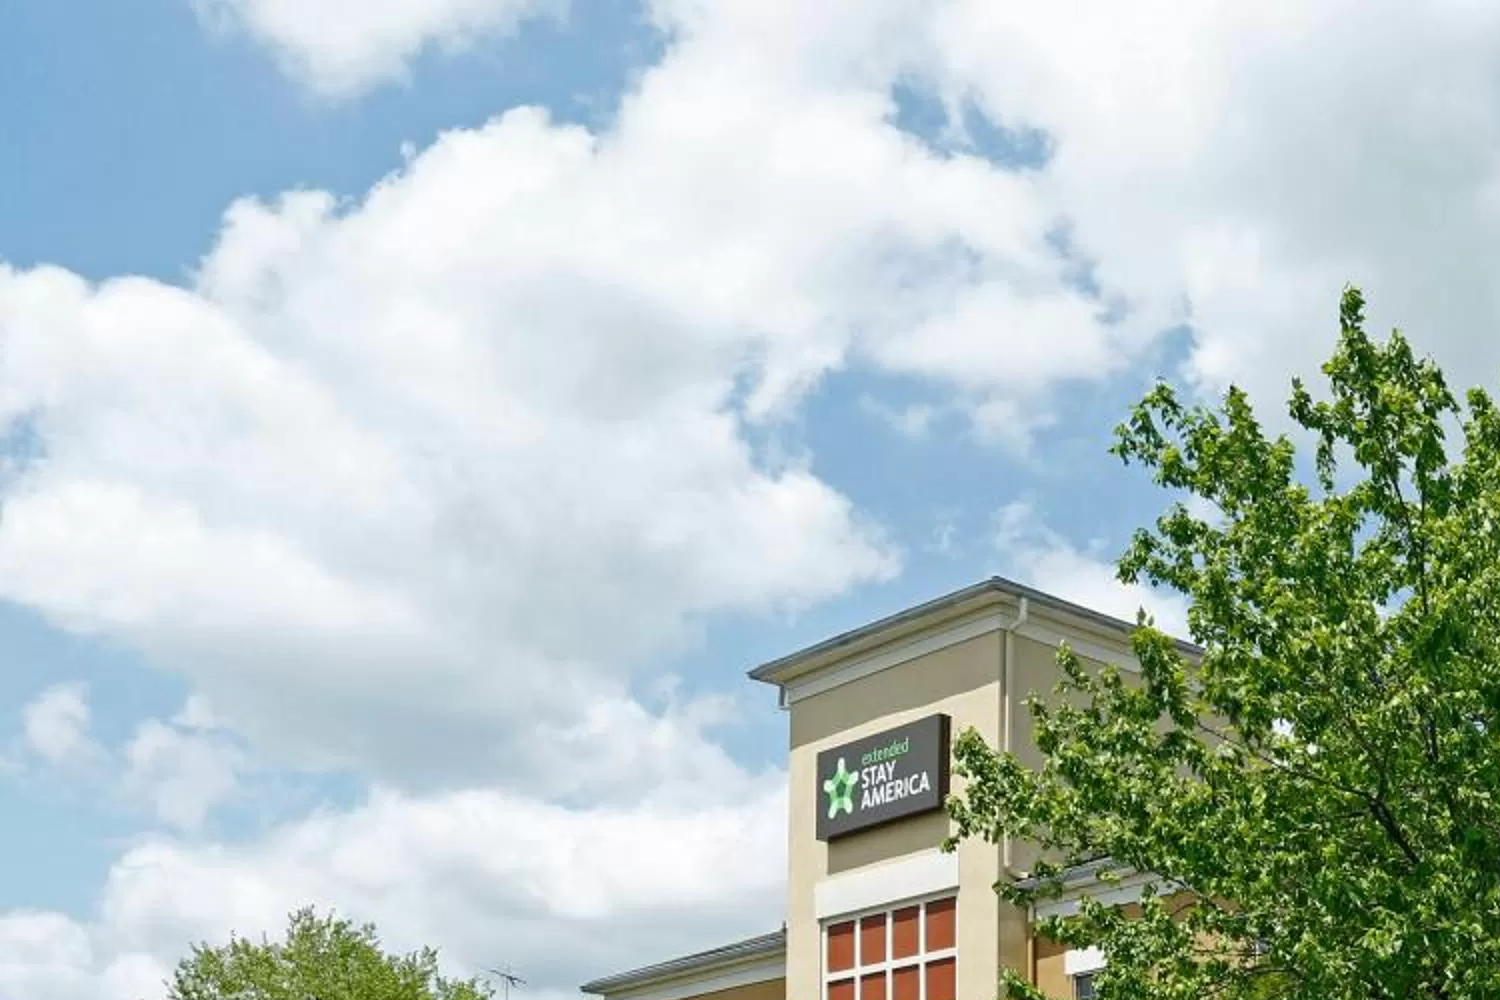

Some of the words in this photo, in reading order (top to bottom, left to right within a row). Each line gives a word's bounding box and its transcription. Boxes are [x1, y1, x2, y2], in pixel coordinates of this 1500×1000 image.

[861, 737, 909, 765] extended
[861, 760, 897, 789] STAY
[861, 772, 931, 811] AMERICA
